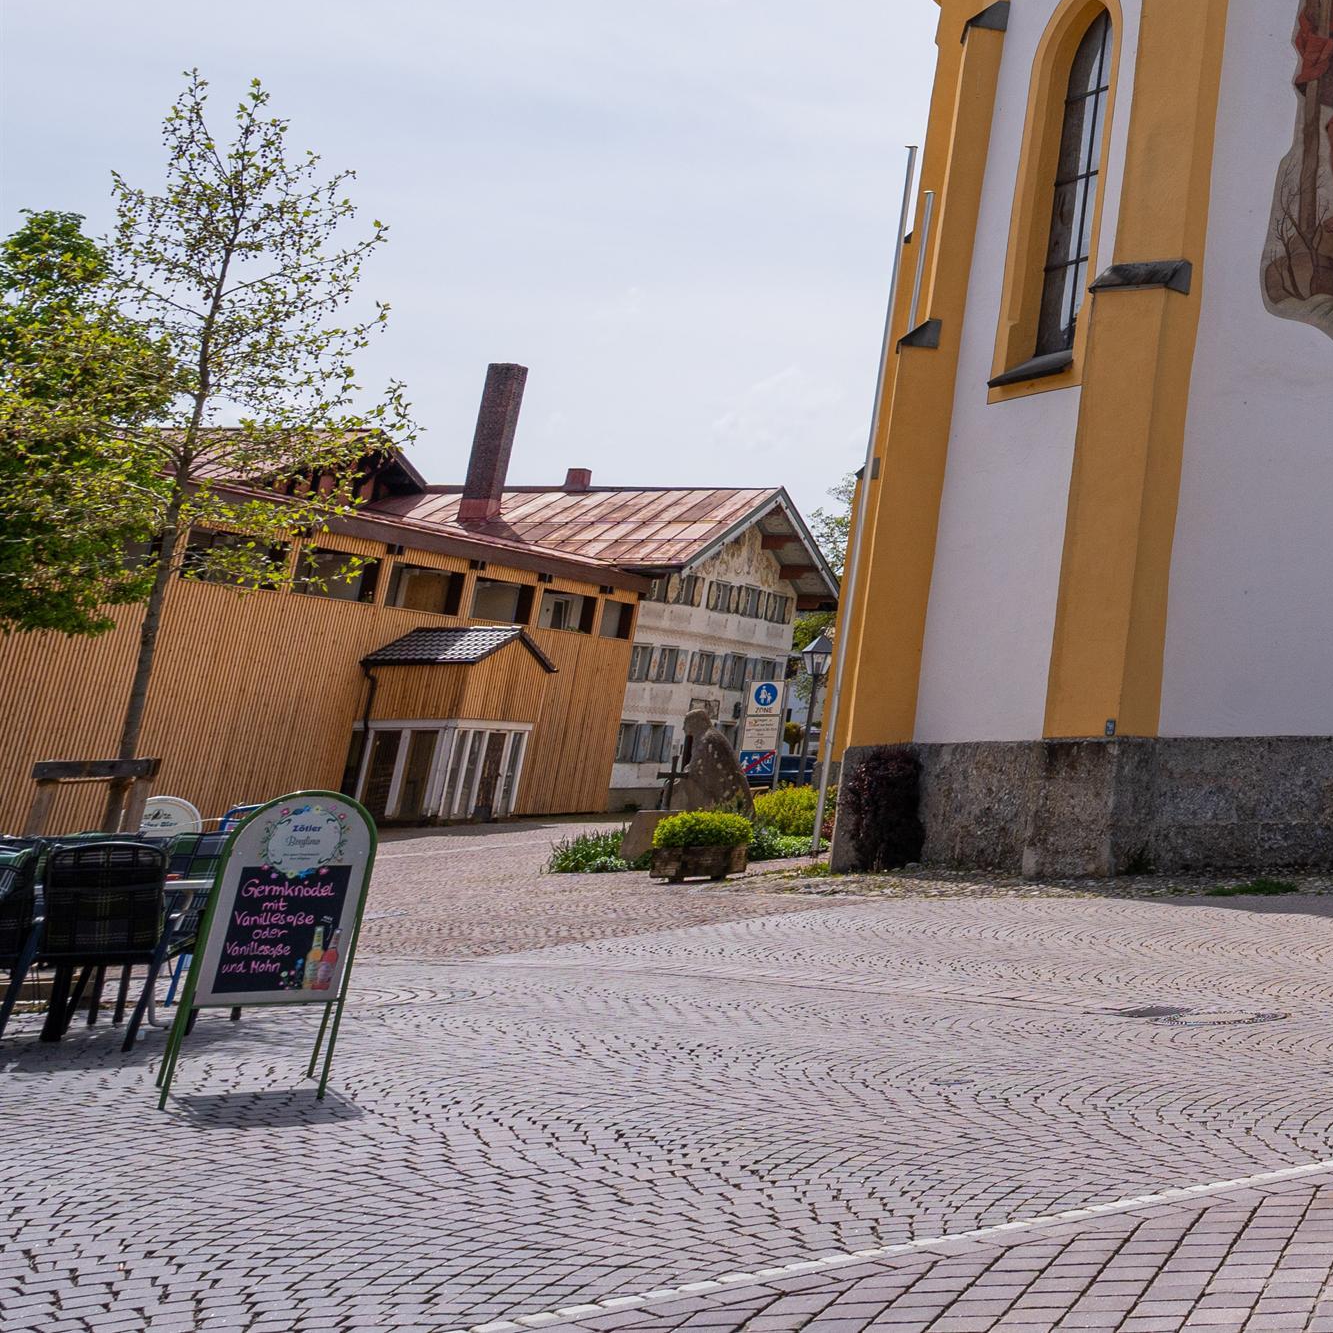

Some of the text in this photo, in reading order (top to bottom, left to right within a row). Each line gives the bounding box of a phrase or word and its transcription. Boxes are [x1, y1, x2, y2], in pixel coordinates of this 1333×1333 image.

[755, 706, 773, 714] ZONE
[292, 824, 323, 833] Zötler
[261, 899, 288, 911] mit
[234, 910, 315, 927] Vanillesoße
[252, 928, 289, 940] oder
[226, 940, 292, 958] Vanillesoße
[221, 960, 248, 974] und
